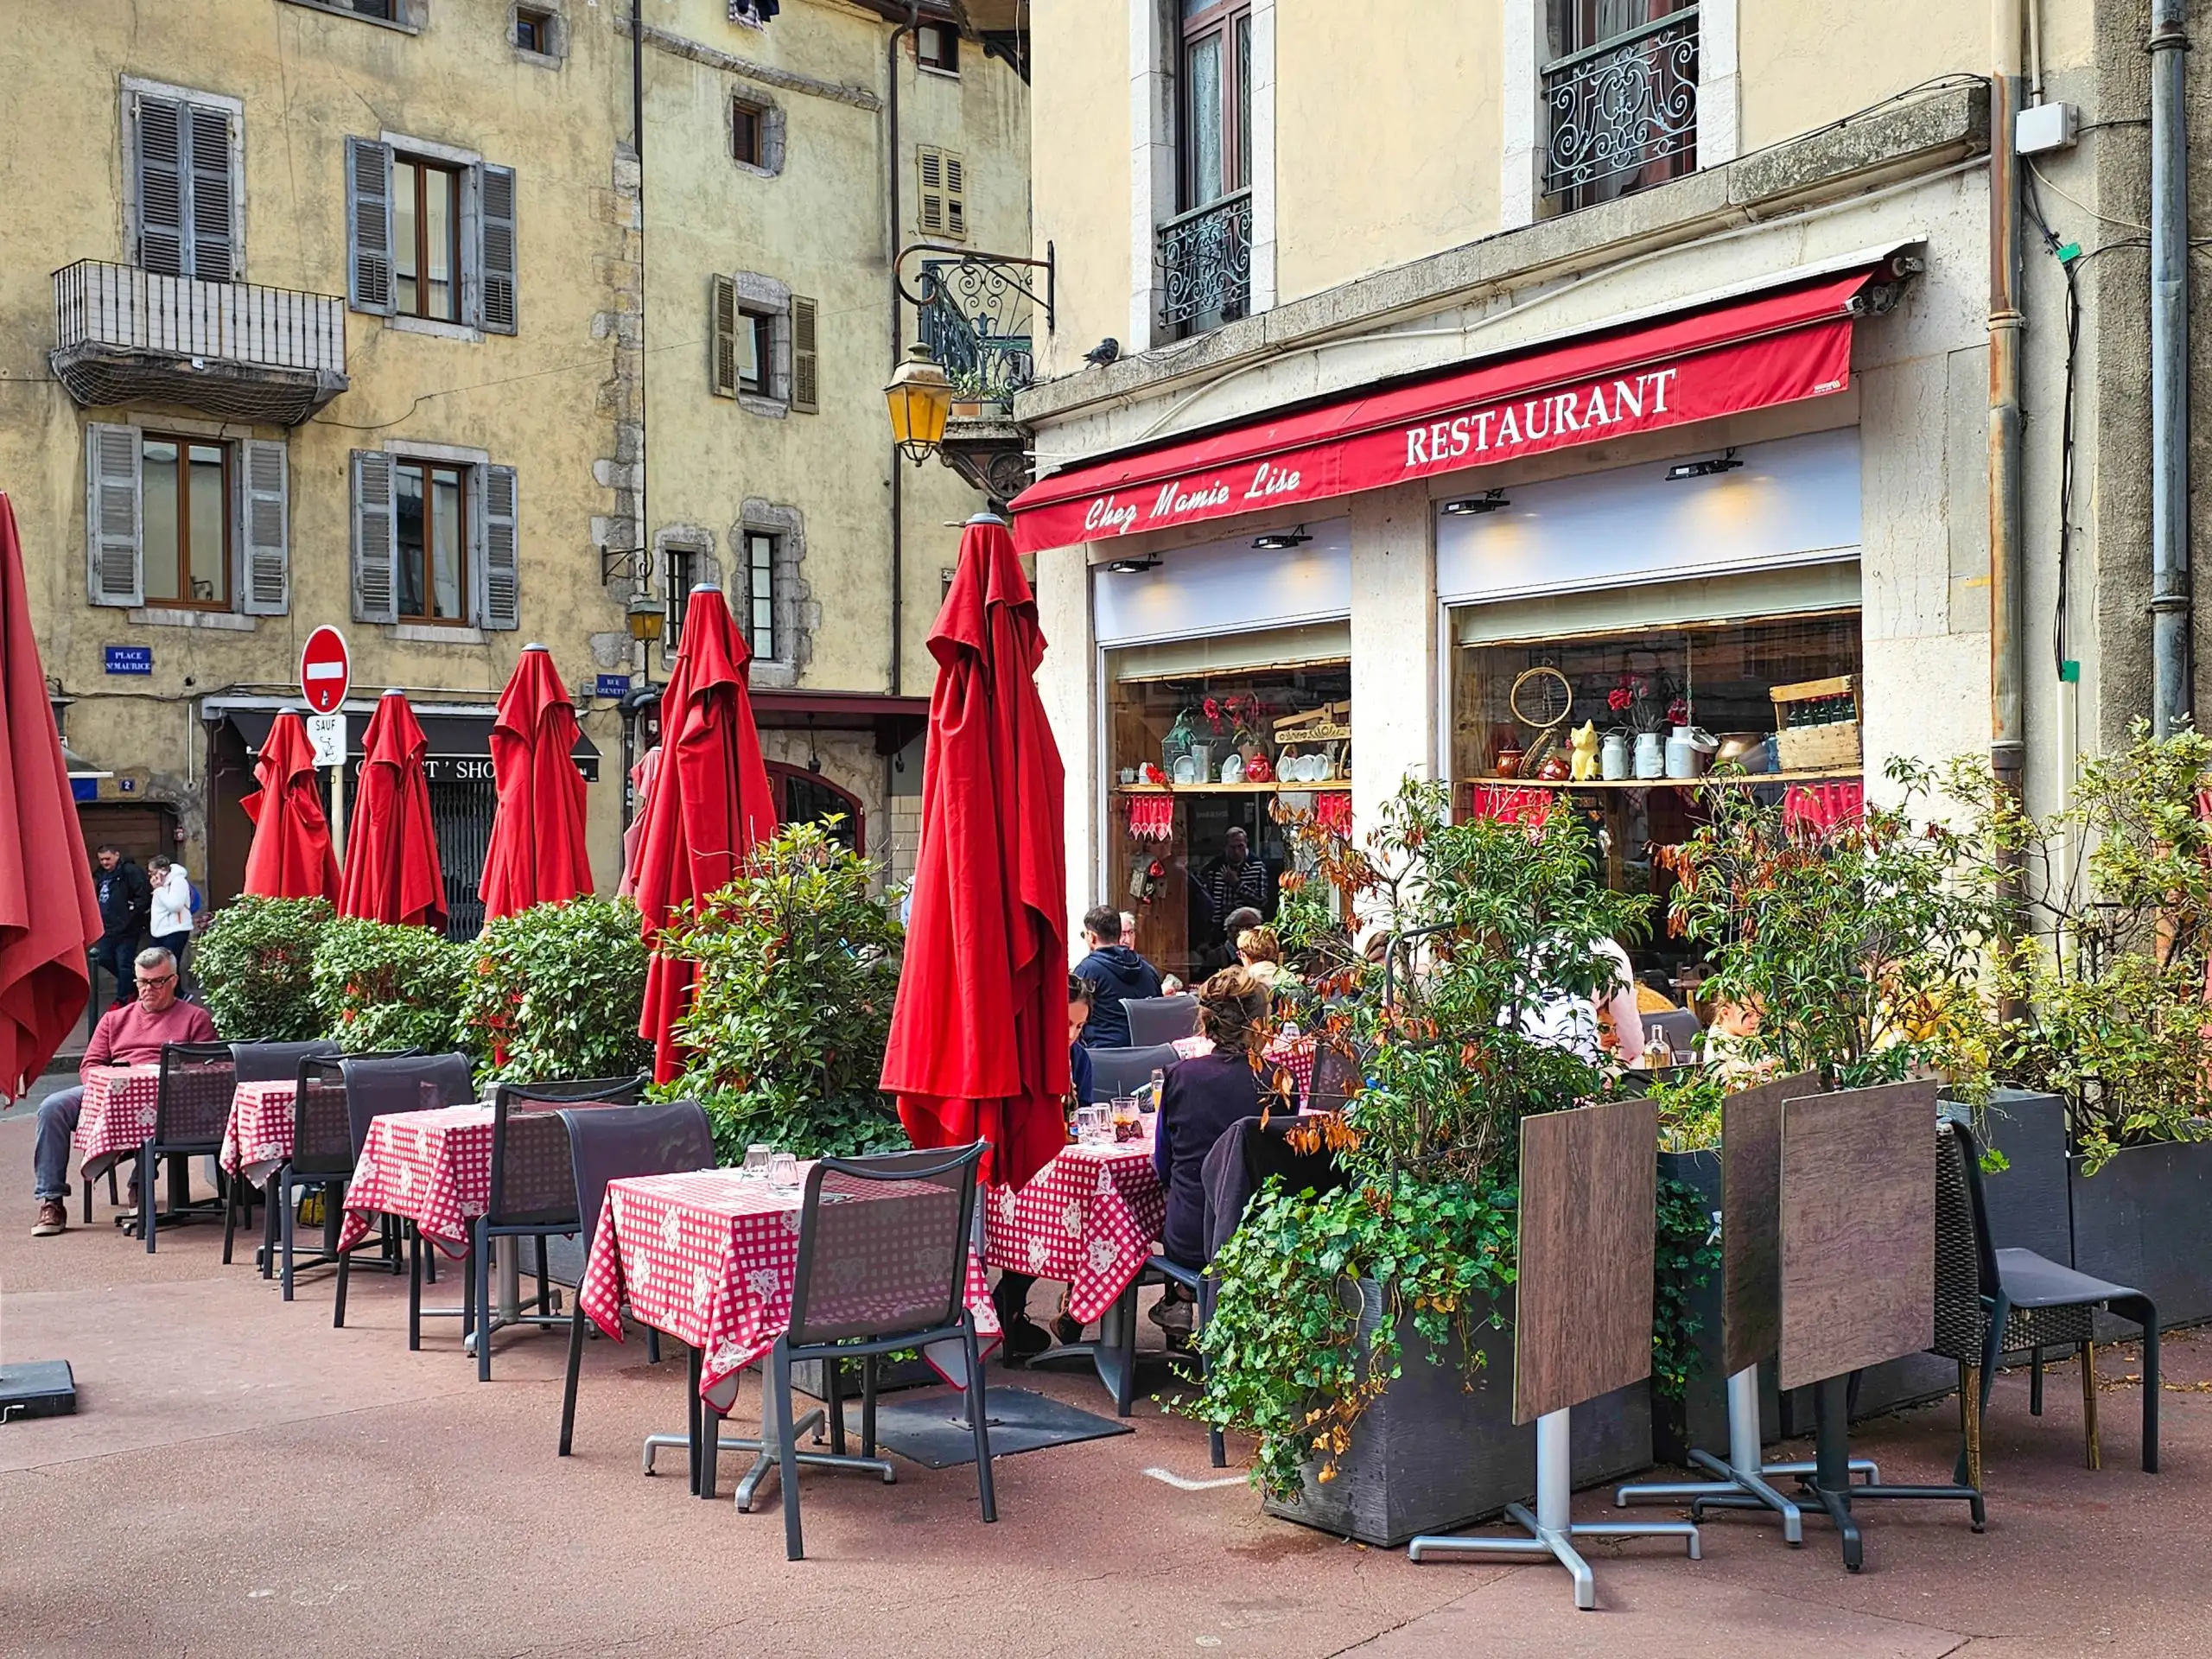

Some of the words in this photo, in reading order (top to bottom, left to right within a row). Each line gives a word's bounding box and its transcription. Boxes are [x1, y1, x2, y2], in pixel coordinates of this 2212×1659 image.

[1405, 368, 1676, 467] RESTAURANT
[1084, 494, 1138, 535] Chez
[1149, 481, 1230, 518] Mamie
[1244, 462, 1300, 499] Lise
[114, 662, 150, 671] MAURICE
[315, 719, 336, 731] SAUF
[124, 780, 130, 790] 2
